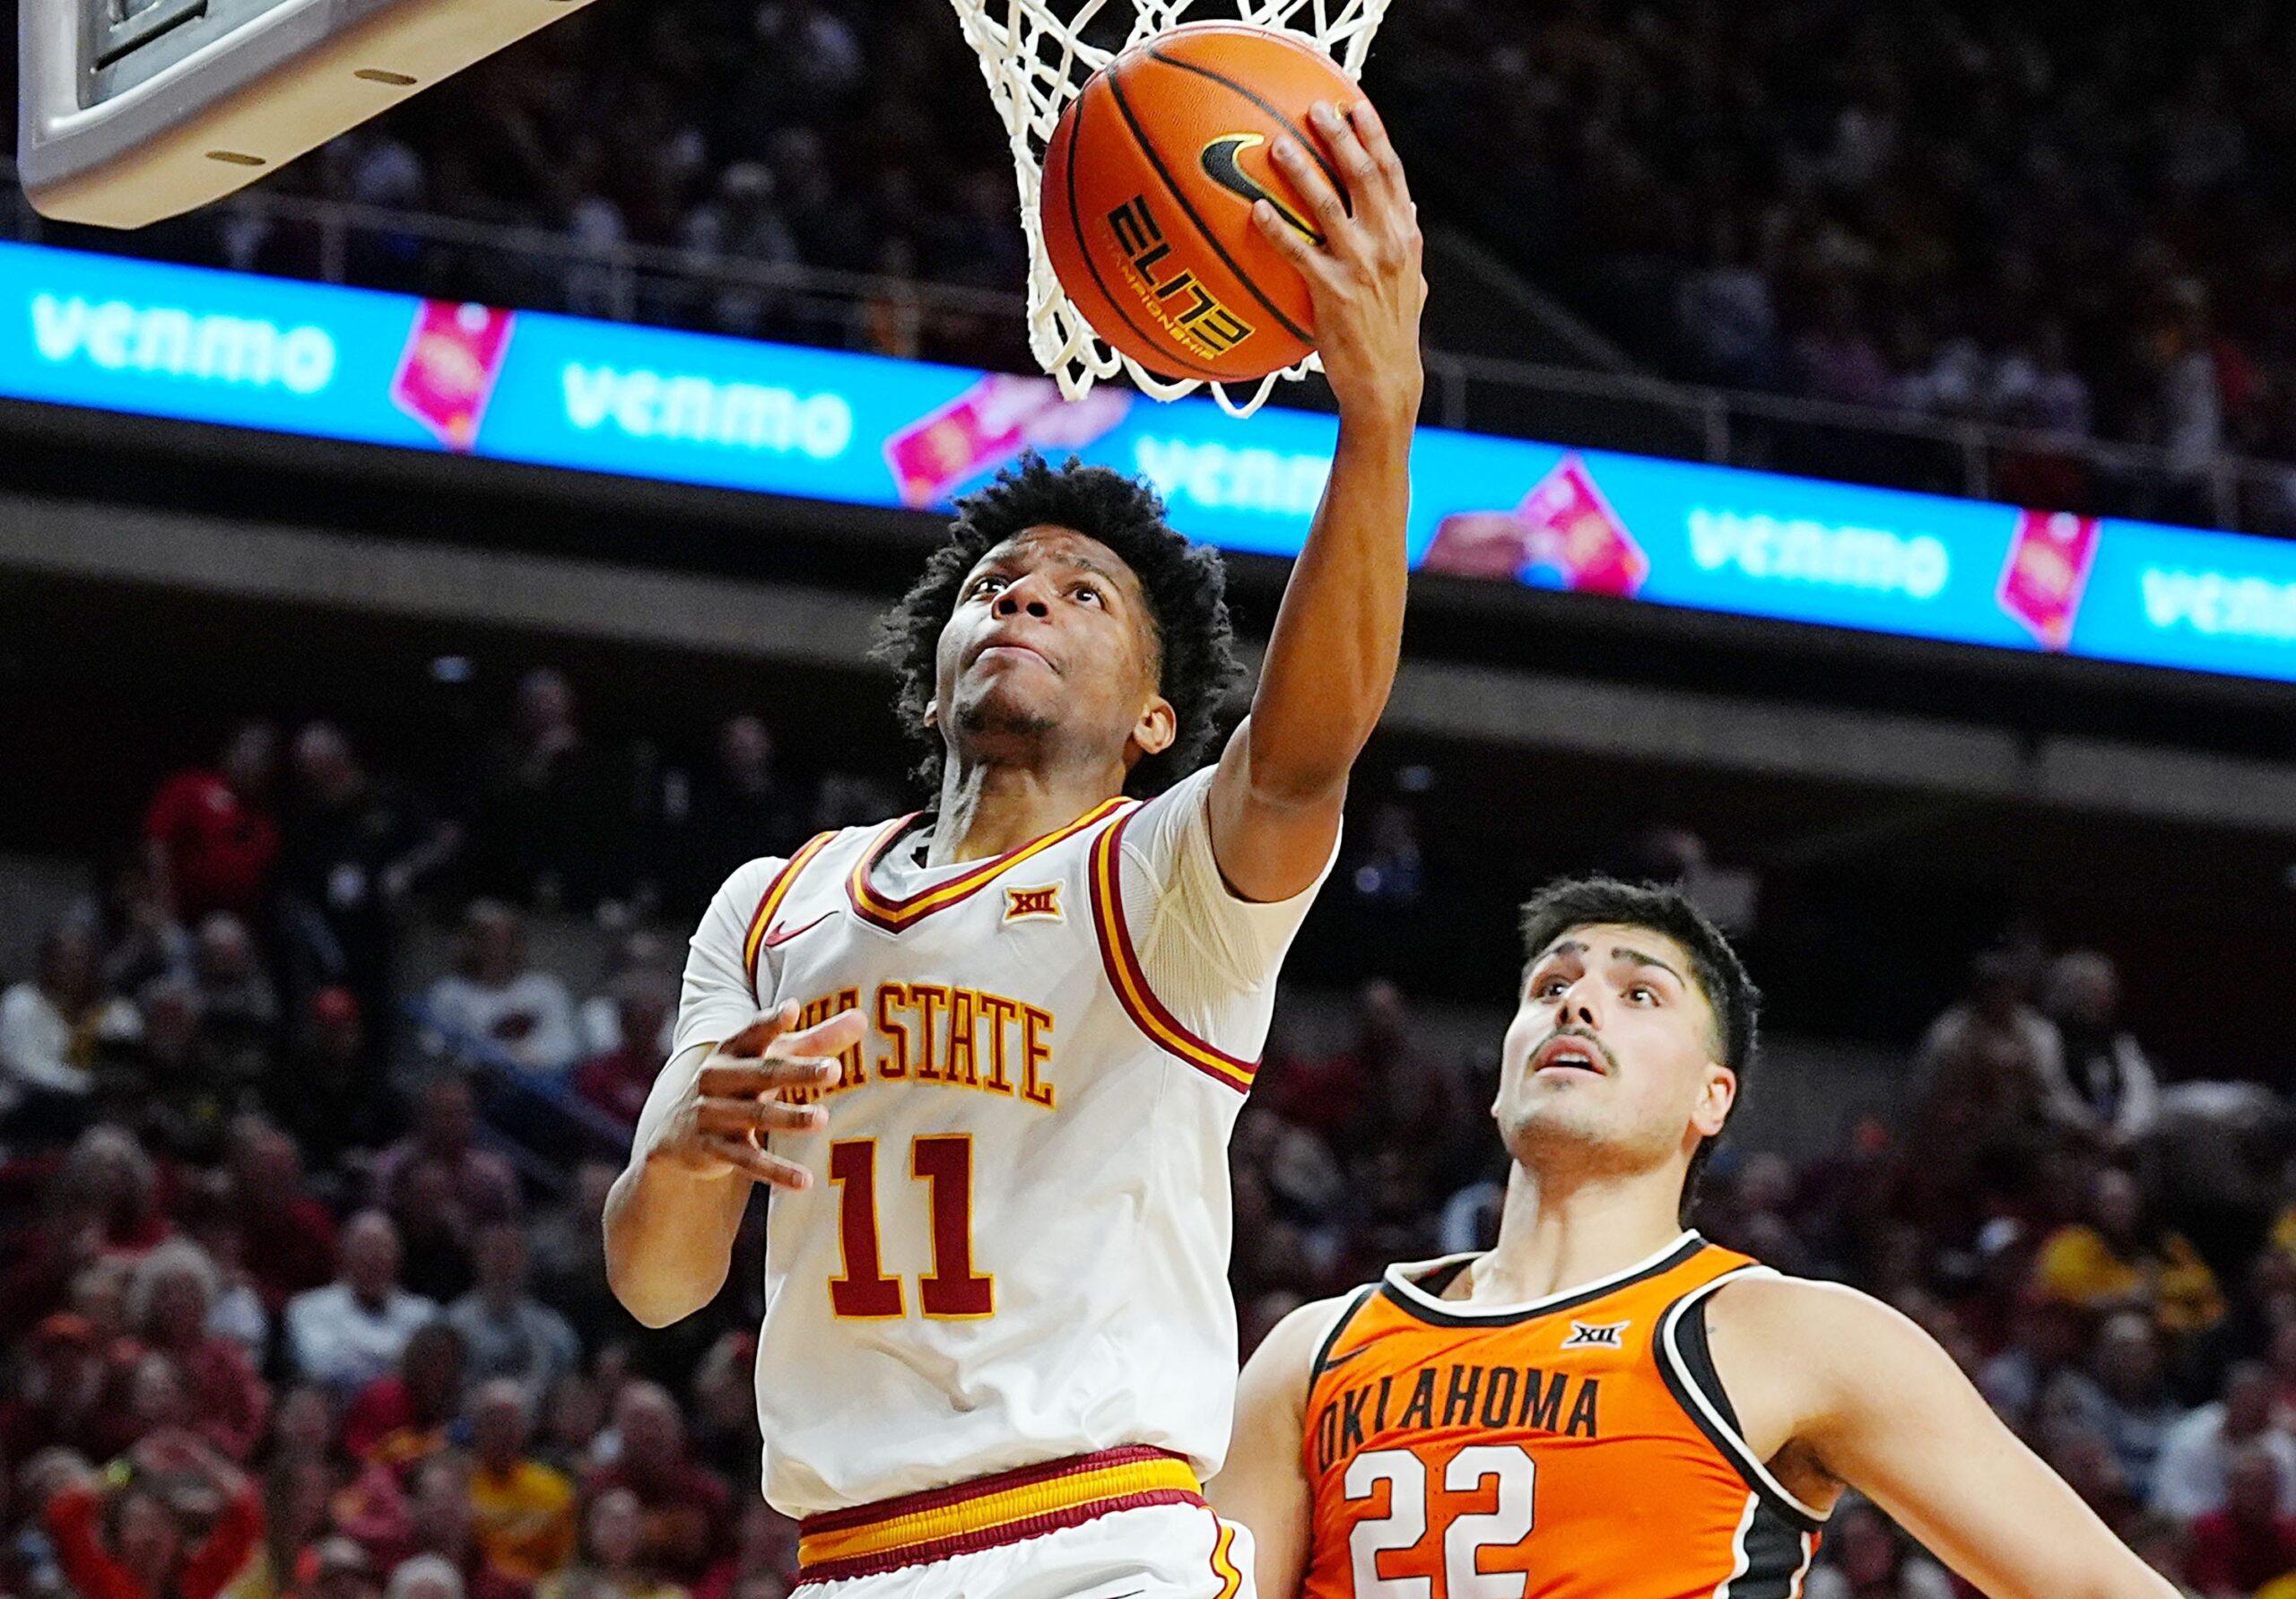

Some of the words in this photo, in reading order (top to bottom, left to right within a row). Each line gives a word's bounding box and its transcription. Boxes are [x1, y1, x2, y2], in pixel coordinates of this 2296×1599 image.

[1108, 194, 1257, 356] ELITE
[32, 294, 335, 393] venmo
[563, 363, 851, 457] venmo
[1689, 508, 1948, 598] venmo
[2142, 569, 2296, 639] ven
[1009, 887, 1056, 916] XII
[875, 980, 1057, 1109] STATE
[829, 1132, 995, 1320] 11
[1318, 1364, 1599, 1475] OKLAHOMA
[1344, 1446, 1535, 1599] 22
